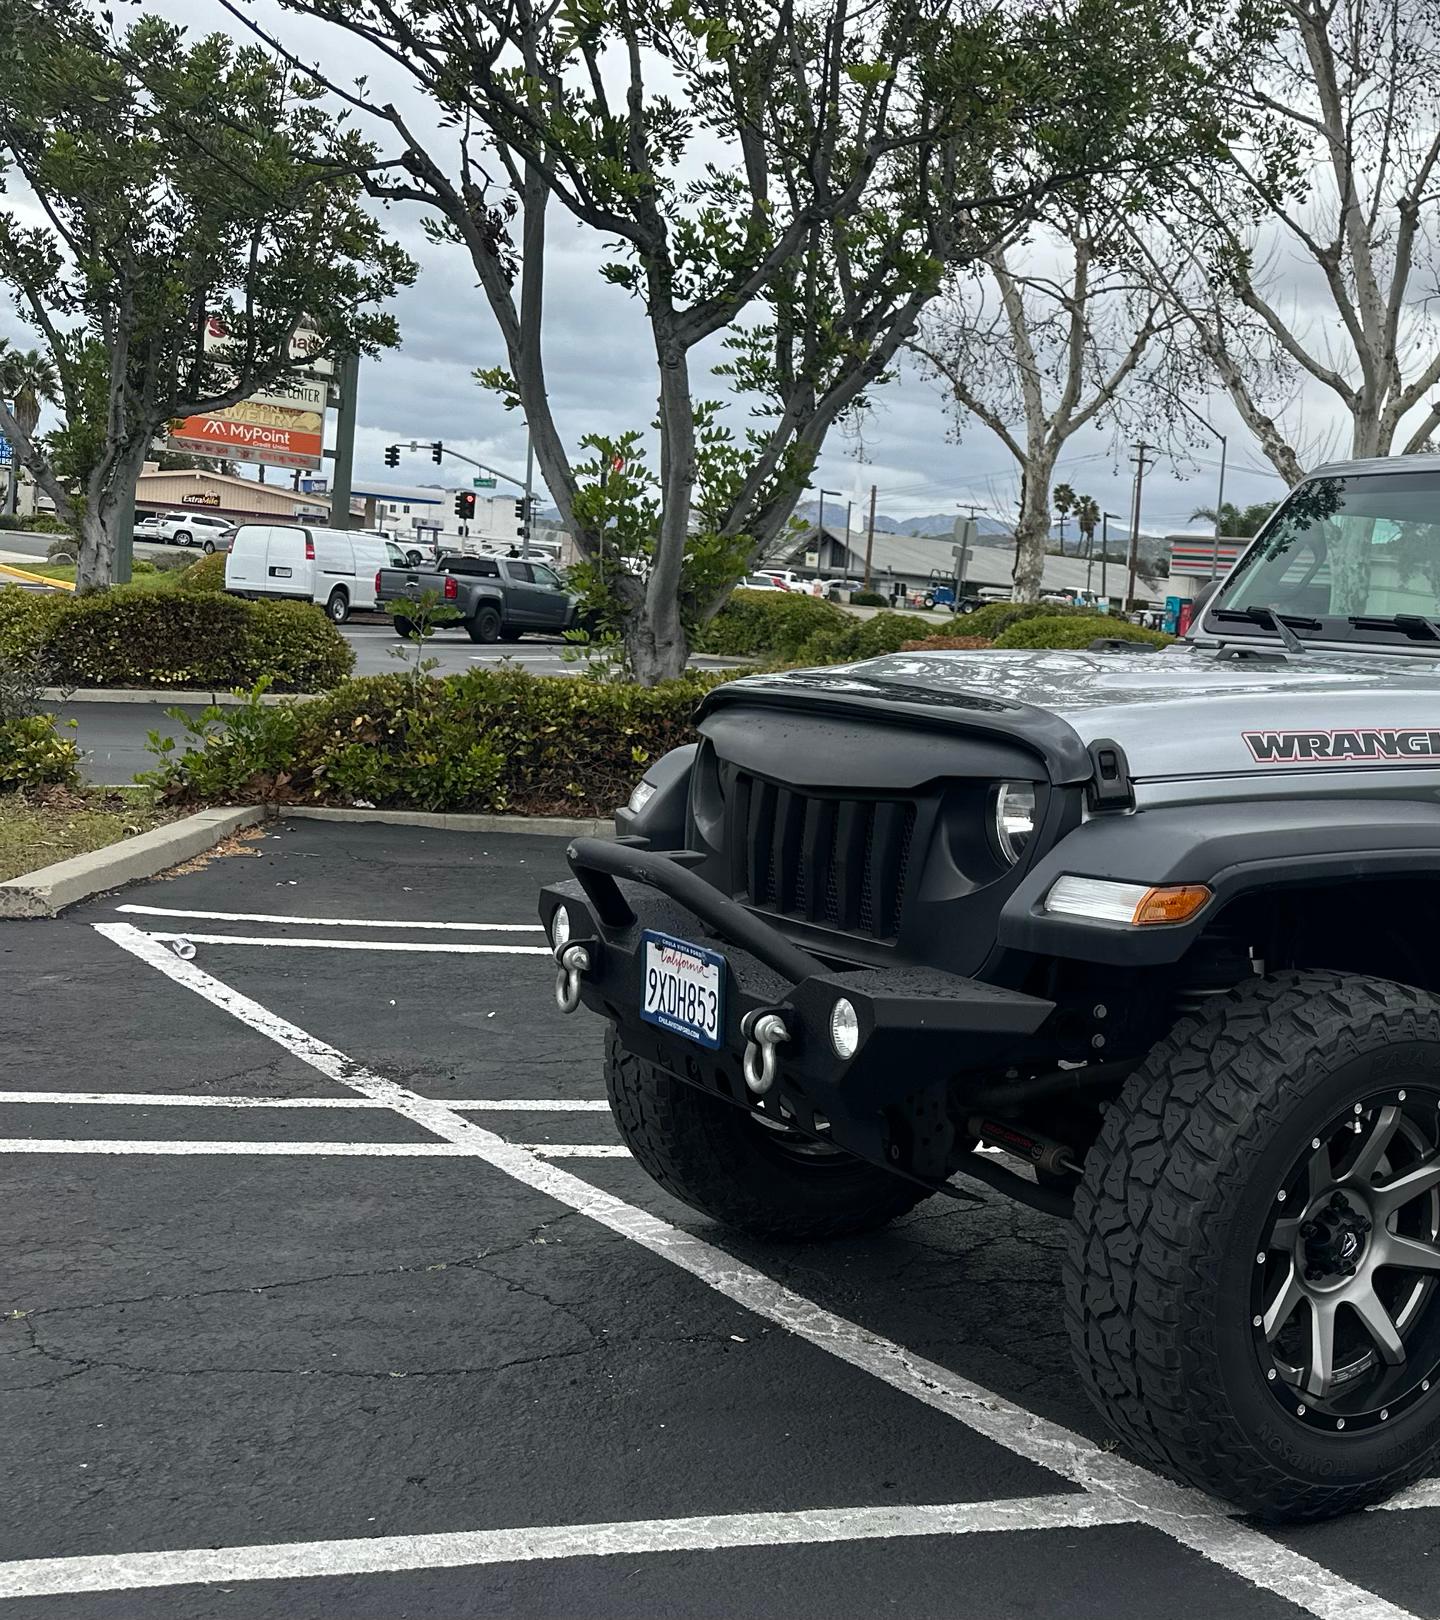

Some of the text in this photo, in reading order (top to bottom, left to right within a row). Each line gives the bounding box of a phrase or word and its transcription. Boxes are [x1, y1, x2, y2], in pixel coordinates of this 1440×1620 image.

[230, 424, 290, 445] MyPoint
[252, 441, 271, 449] Credit
[183, 494, 219, 505] ExtraMile
[661, 947, 709, 978] California
[648, 967, 717, 1033] 9XDH853
